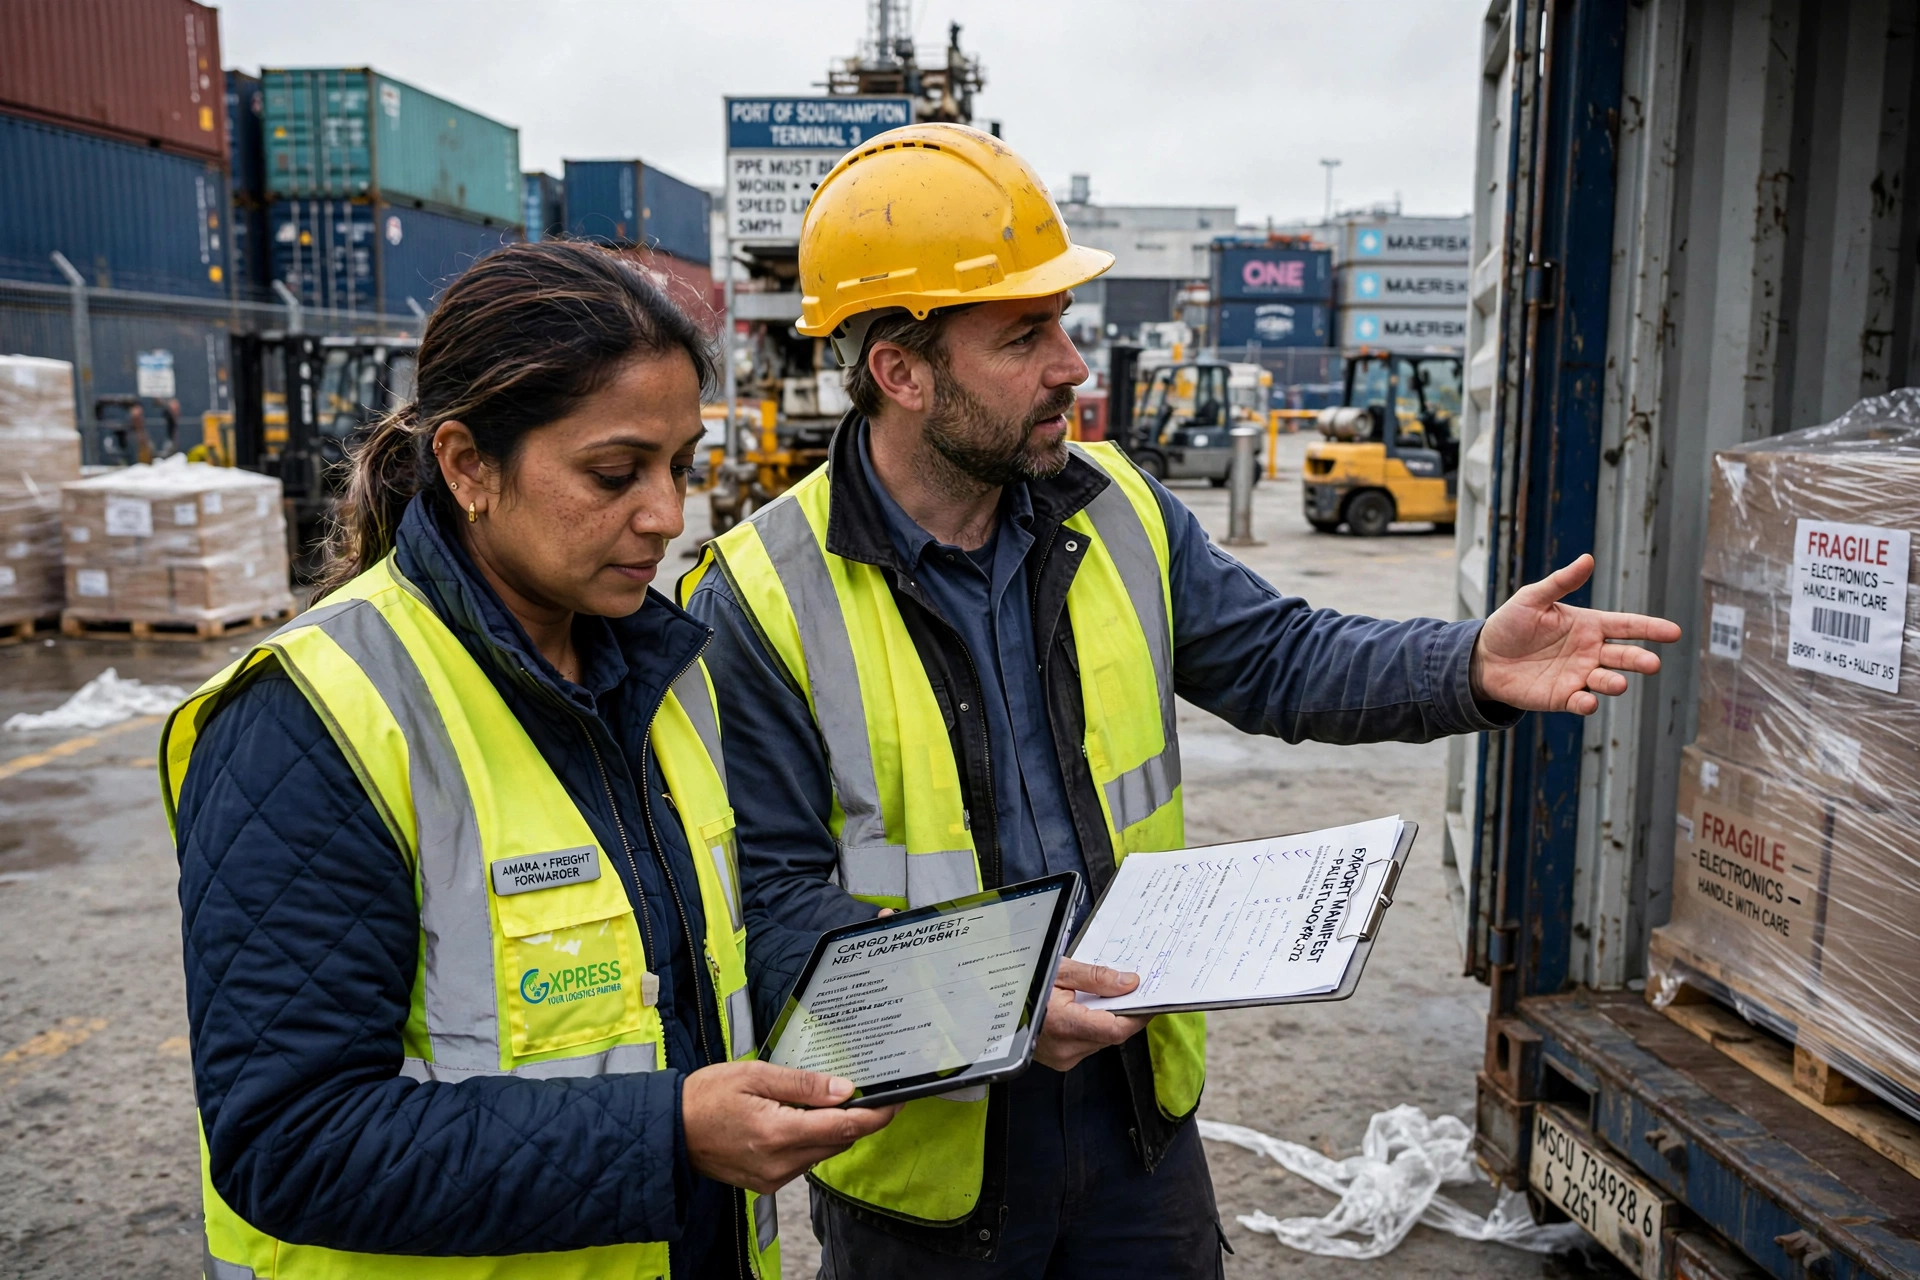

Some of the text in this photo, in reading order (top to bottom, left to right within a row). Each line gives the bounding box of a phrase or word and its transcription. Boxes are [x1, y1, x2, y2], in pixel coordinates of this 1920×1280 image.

[731, 103, 907, 123] PORT OF SOUTHAMPTON
[769, 126, 862, 146] TERMINAL 3
[735, 159, 763, 174] PPE
[769, 159, 811, 175] MUST
[1242, 260, 1305, 287] ONE
[1807, 531, 1889, 566] FRAGILE
[1811, 563, 1878, 588] ELECTRONICS
[1838, 589, 1860, 605] WITH
[1861, 593, 1888, 611] CARE
[1702, 812, 1785, 874] FRAGILE
[550, 852, 591, 868] FREIGHT
[1699, 849, 1784, 904] ELECTRONICS
[1698, 876, 1790, 937] HANDLE WITH CARE
[837, 935, 888, 954] CARGO
[1307, 899, 1347, 963] MANIFEST
[1537, 1117, 1653, 1238] MSCU 734928 6
[1544, 1162, 1597, 1233] 6 2261
